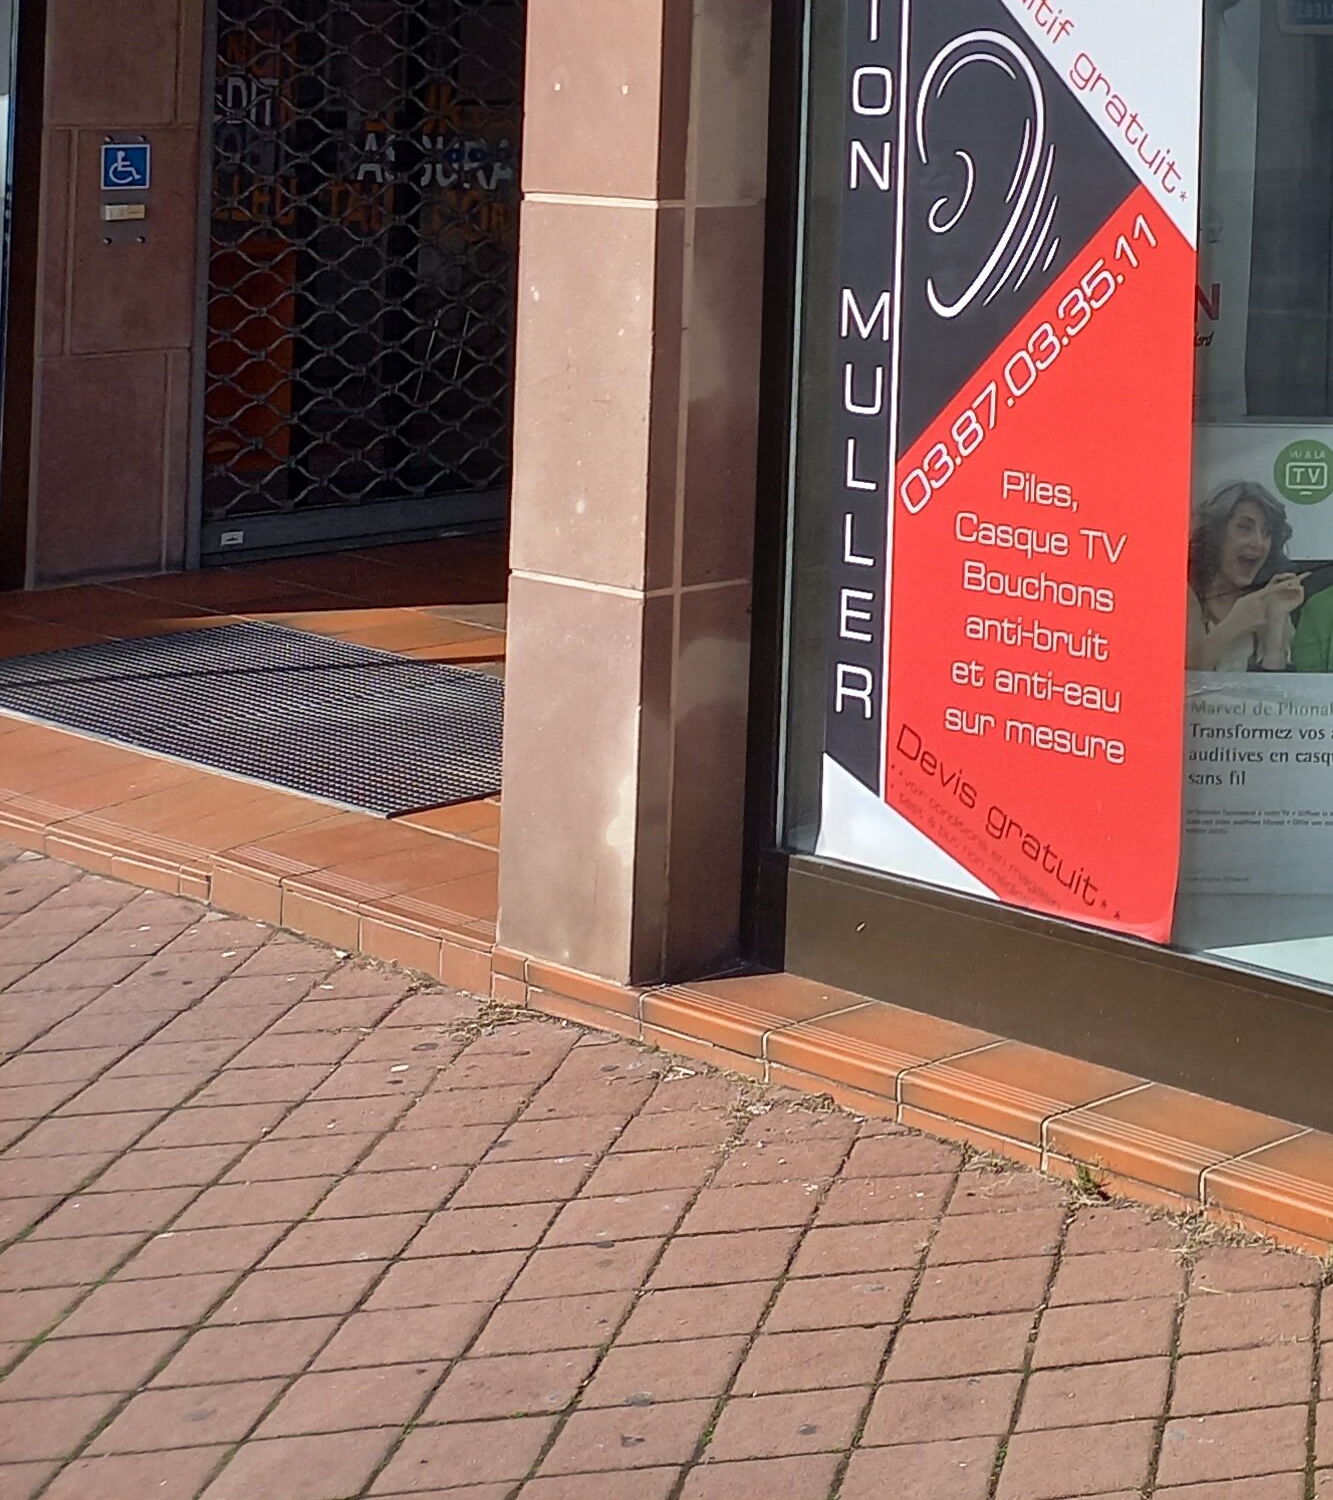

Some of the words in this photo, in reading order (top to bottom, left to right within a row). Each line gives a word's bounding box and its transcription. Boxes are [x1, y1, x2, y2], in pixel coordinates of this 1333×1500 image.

[899, 213, 1158, 514] 03.87.03.35.11
[1002, 469, 1078, 512] Piles,
[1292, 468, 1320, 484] TV
[835, 288, 891, 719] MULLER
[955, 512, 1068, 560] Casque
[1080, 529, 1128, 563] TV
[963, 561, 1115, 612] Bouchons
[966, 613, 1109, 661] anti-bruit
[951, 660, 984, 688] et
[995, 667, 1120, 714] anti-eau
[1190, 701, 1246, 716] Marvel
[1253, 701, 1273, 716] de
[944, 707, 996, 736] sur
[1005, 719, 1125, 764] mesure
[1188, 748, 1263, 763] auditives
[1269, 751, 1289, 763] en
[1189, 723, 1292, 740] Transformez
[1299, 728, 1325, 740] vos
[896, 723, 978, 809] Devis
[1188, 773, 1222, 786] sans
[1229, 771, 1246, 786] fil
